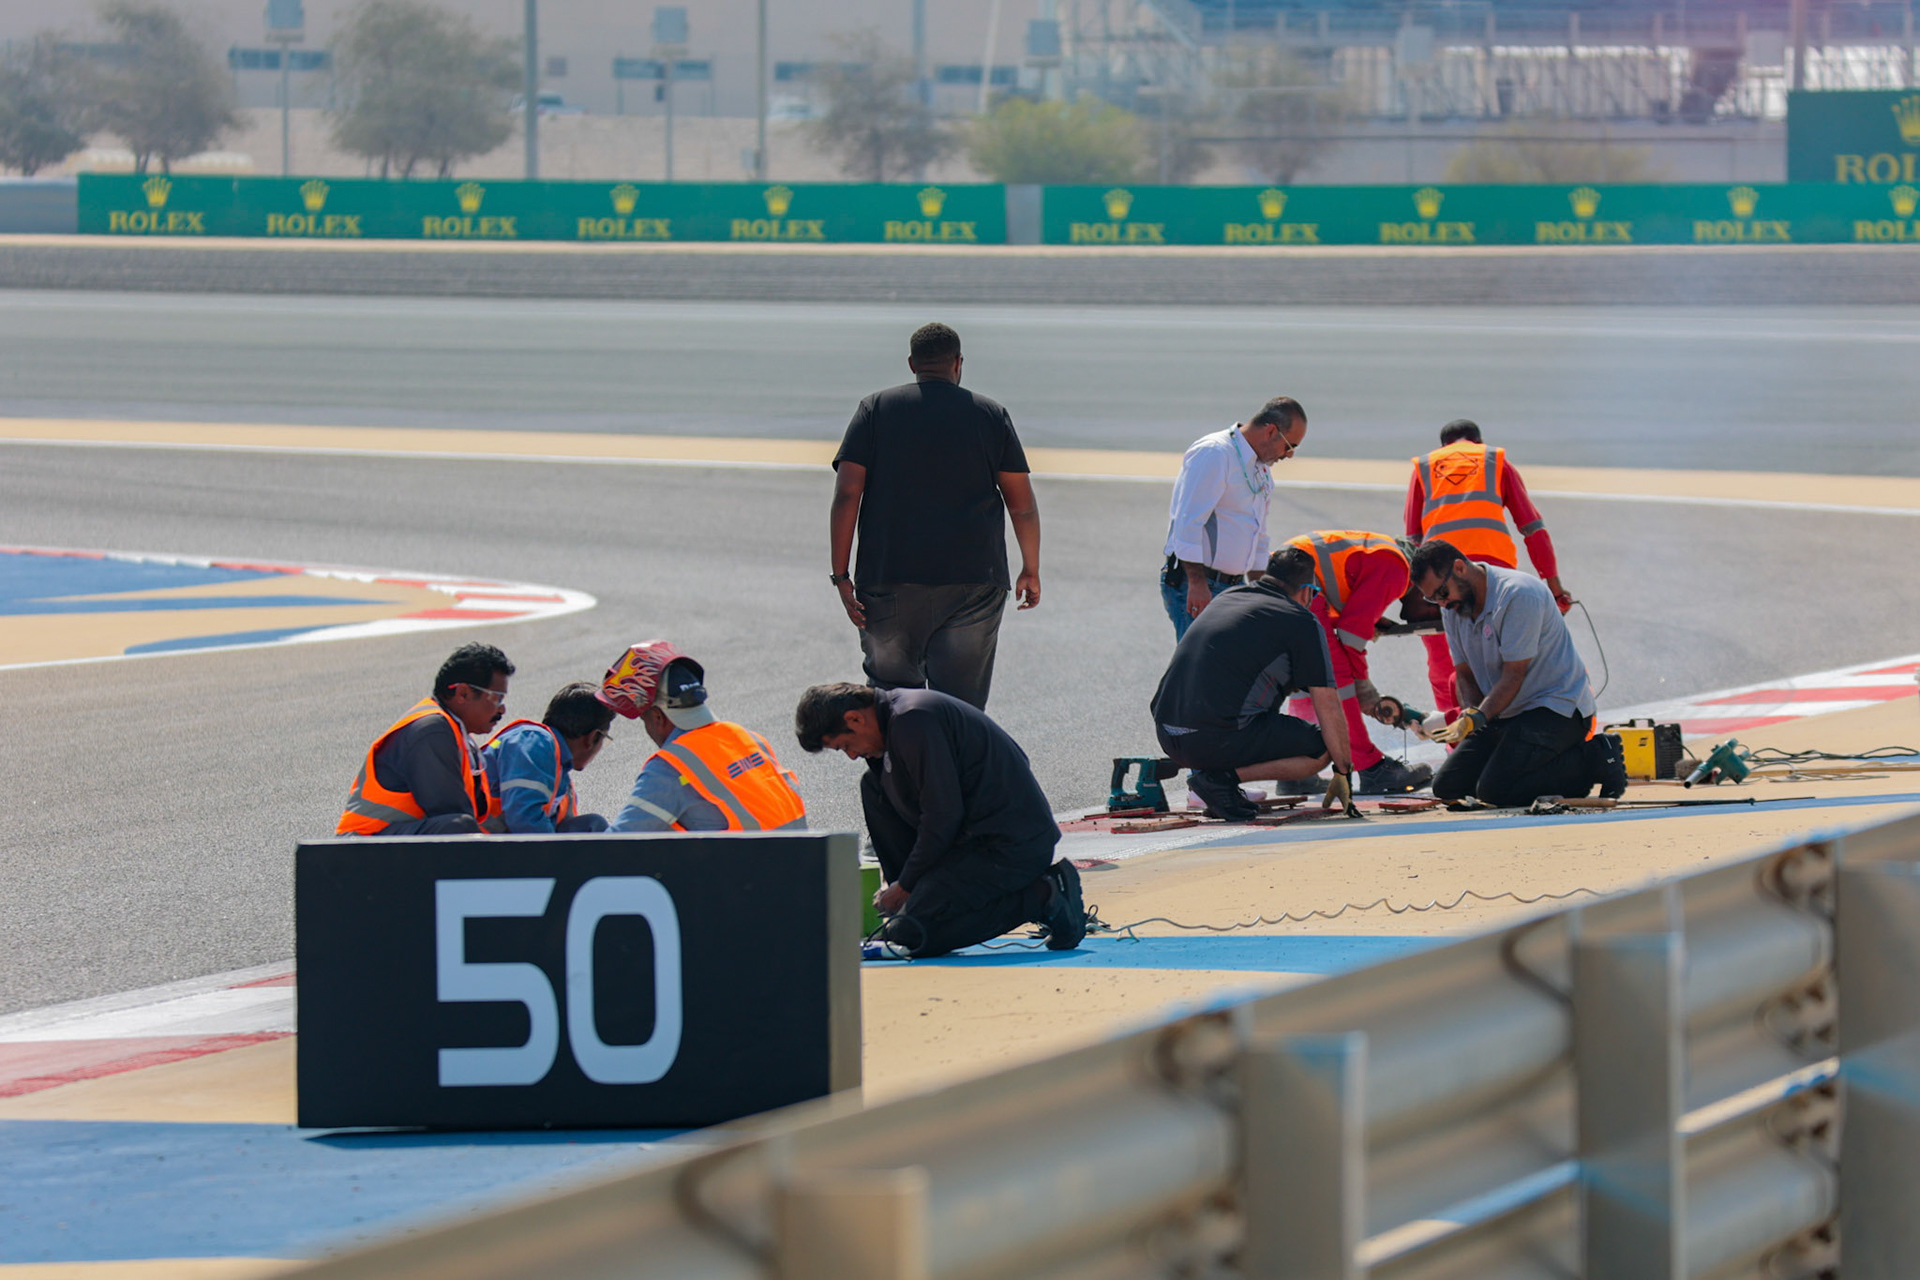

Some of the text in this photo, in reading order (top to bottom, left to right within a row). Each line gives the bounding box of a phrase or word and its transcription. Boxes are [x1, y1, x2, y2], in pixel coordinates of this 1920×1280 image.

[109, 211, 203, 232] ROLEX
[267, 214, 360, 235] ROLEX
[423, 216, 516, 237] ROLEX
[578, 218, 670, 239] ROLEX
[731, 219, 824, 239] ROLEX
[885, 220, 976, 241] ROLEX
[1537, 222, 1631, 242] ROLEX
[1694, 221, 1790, 242] ROLEX
[1071, 223, 1164, 243] ROLEX
[1225, 223, 1319, 243] ROLEX
[1380, 222, 1475, 243] ROLEX
[435, 875, 683, 1087] 50
